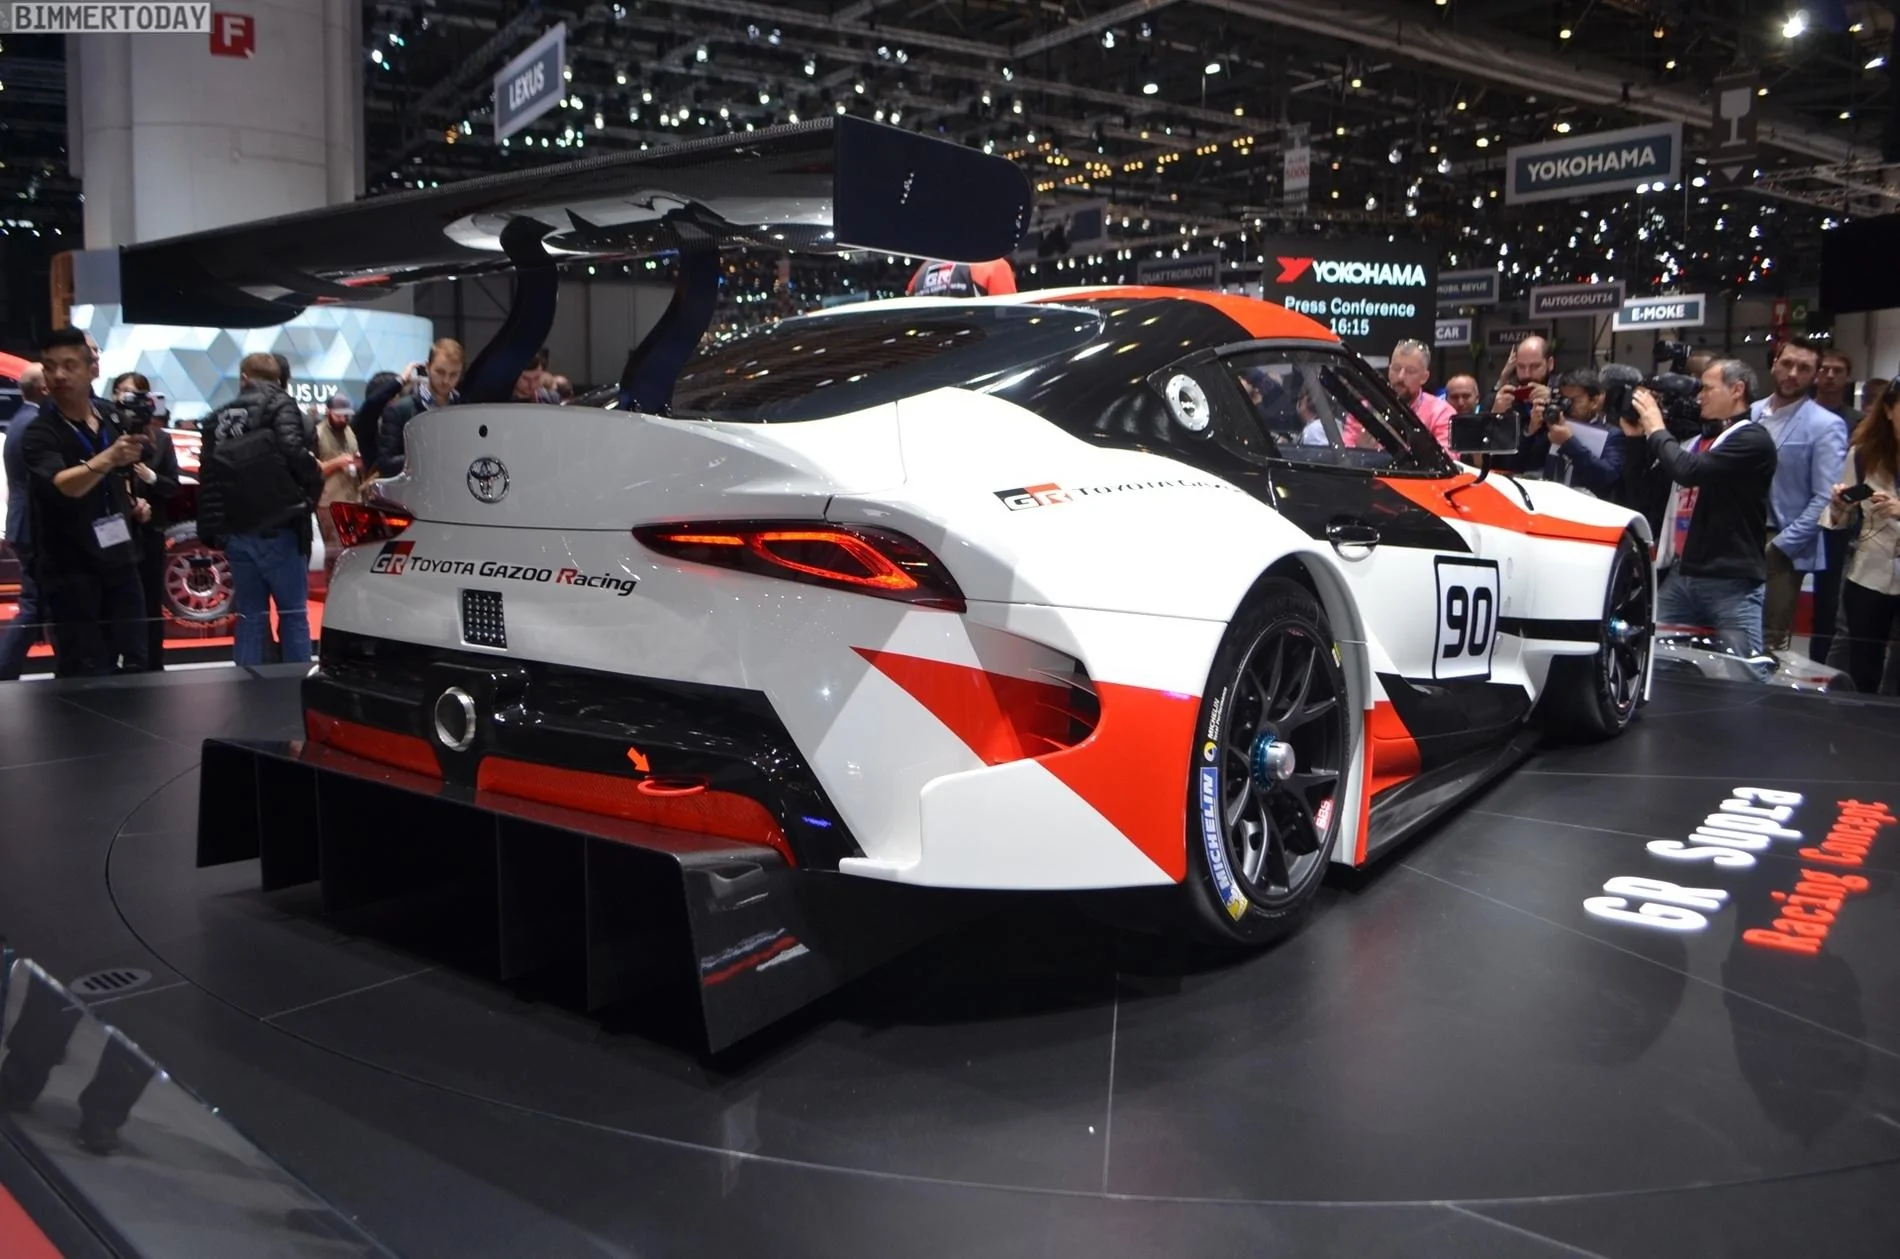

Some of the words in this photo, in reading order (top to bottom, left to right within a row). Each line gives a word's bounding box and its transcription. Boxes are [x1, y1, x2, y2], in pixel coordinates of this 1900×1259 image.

[223, 16, 246, 47] F
[509, 61, 545, 112] LEXUS
[1528, 145, 1656, 183] YOKOHAMA
[1312, 260, 1427, 287] YOKOHAMA
[1462, 281, 1488, 292] REVUE
[1284, 295, 1327, 314] Press
[1330, 297, 1416, 318] Conference
[1540, 292, 1613, 309] AUTOSCOUT24
[1329, 318, 1370, 336] 16:15
[1002, 490, 1074, 511] GR
[371, 553, 409, 575] GR
[411, 556, 475, 576] TOYOTA
[479, 562, 552, 582] GAZOO
[555, 568, 637, 597] Racing
[1442, 585, 1493, 659] 90
[1207, 697, 1220, 740] MICHELIN
[1203, 773, 1232, 891] MICHELIN
[1315, 800, 1331, 830] BBS
[1646, 786, 1803, 868] Supra
[1799, 799, 1897, 867] Concept
[1583, 876, 1729, 931] GR
[1743, 867, 1870, 956] Racing
